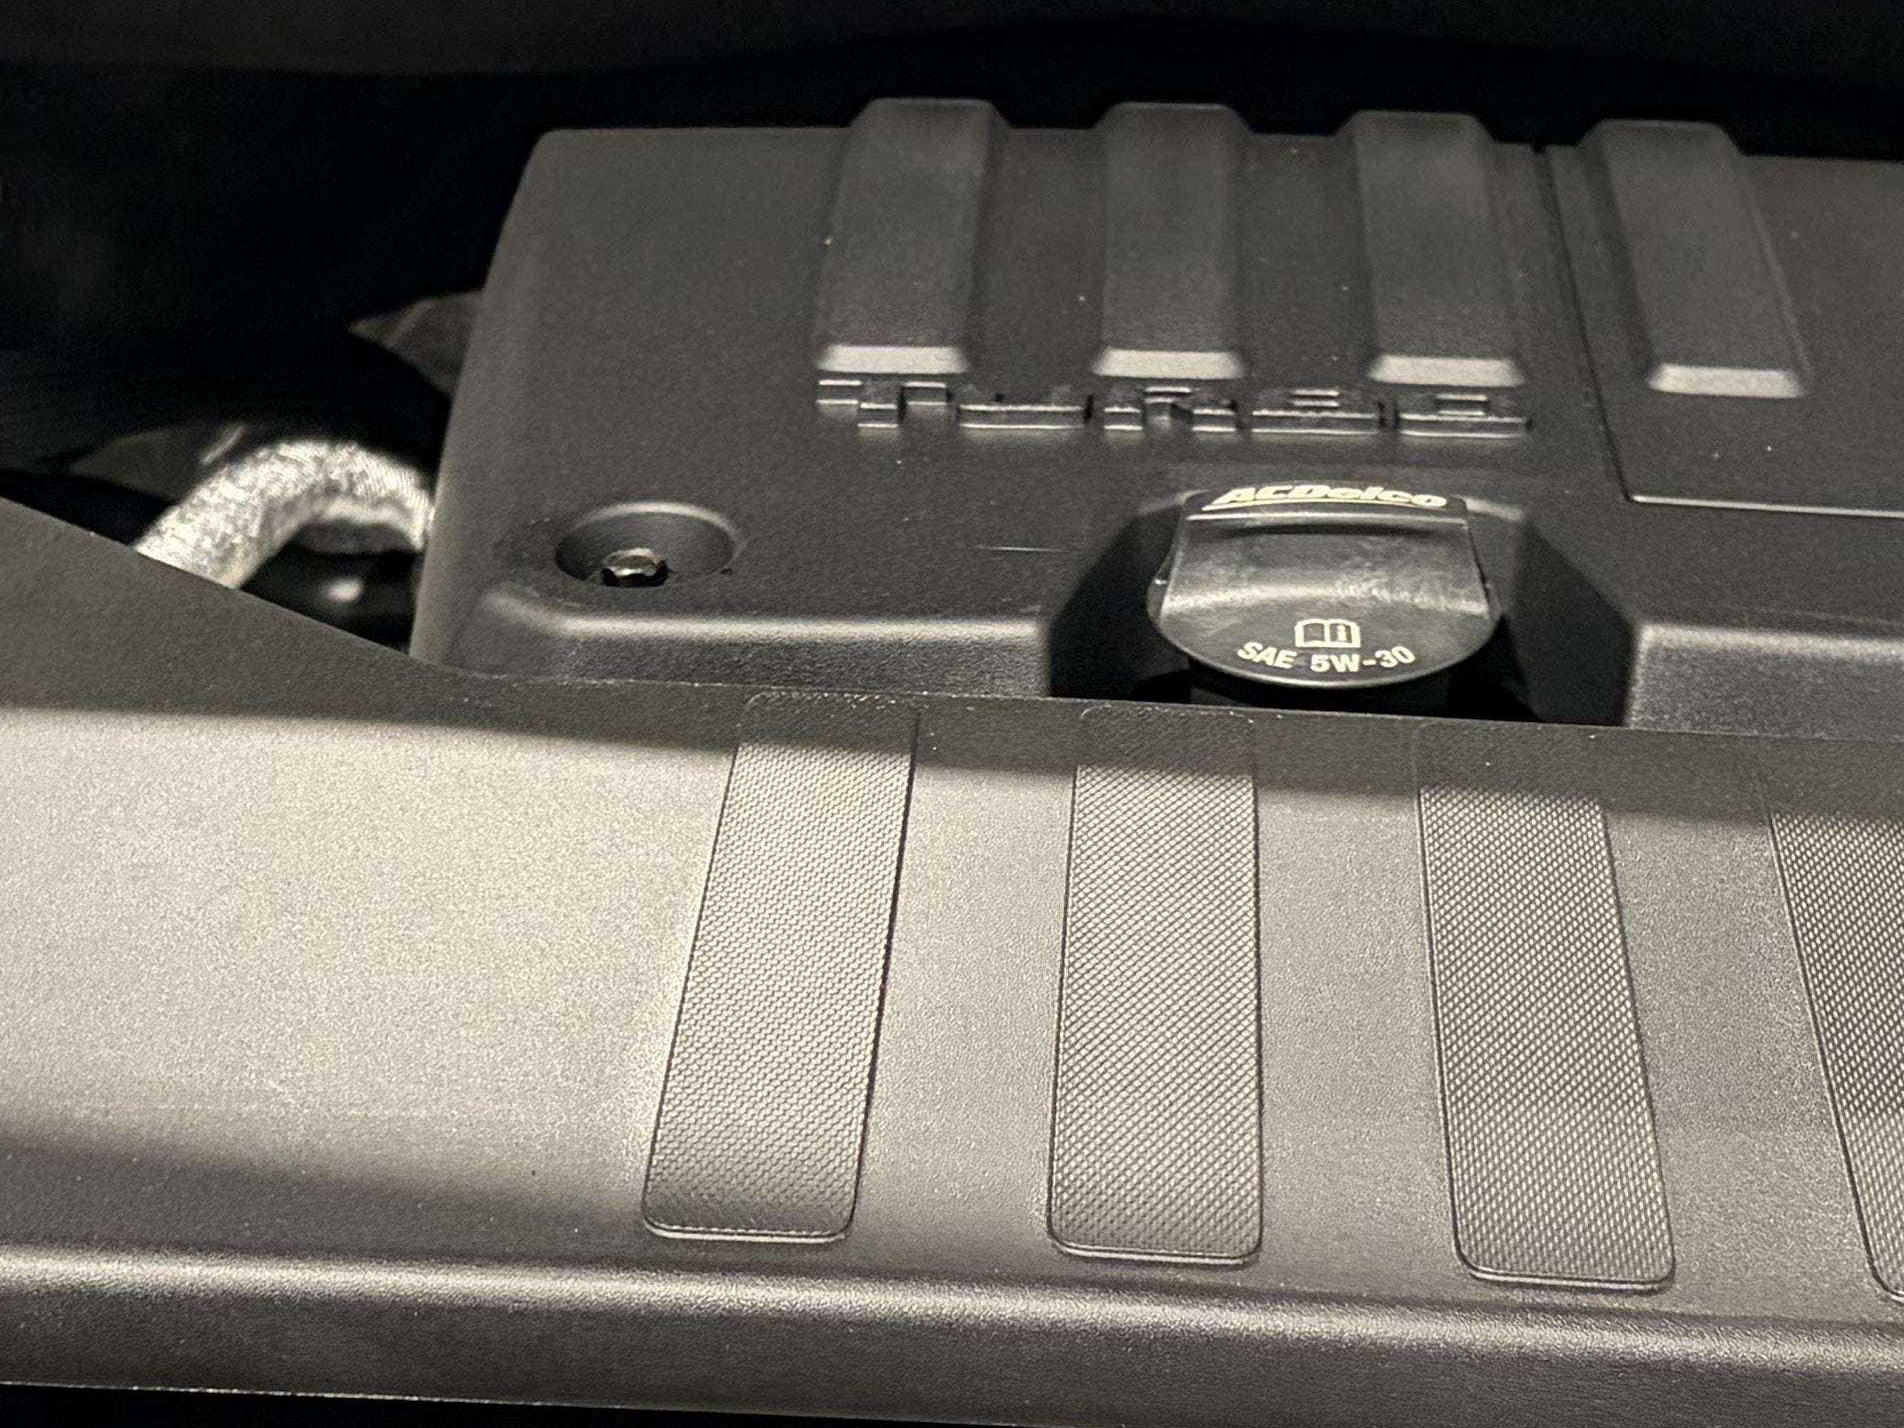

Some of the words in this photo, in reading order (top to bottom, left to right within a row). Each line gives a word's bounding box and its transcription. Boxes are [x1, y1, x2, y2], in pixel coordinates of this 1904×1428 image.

[1202, 485, 1447, 511] ACDelco
[1237, 642, 1298, 669] SAE
[1310, 646, 1416, 673] 5W-30
